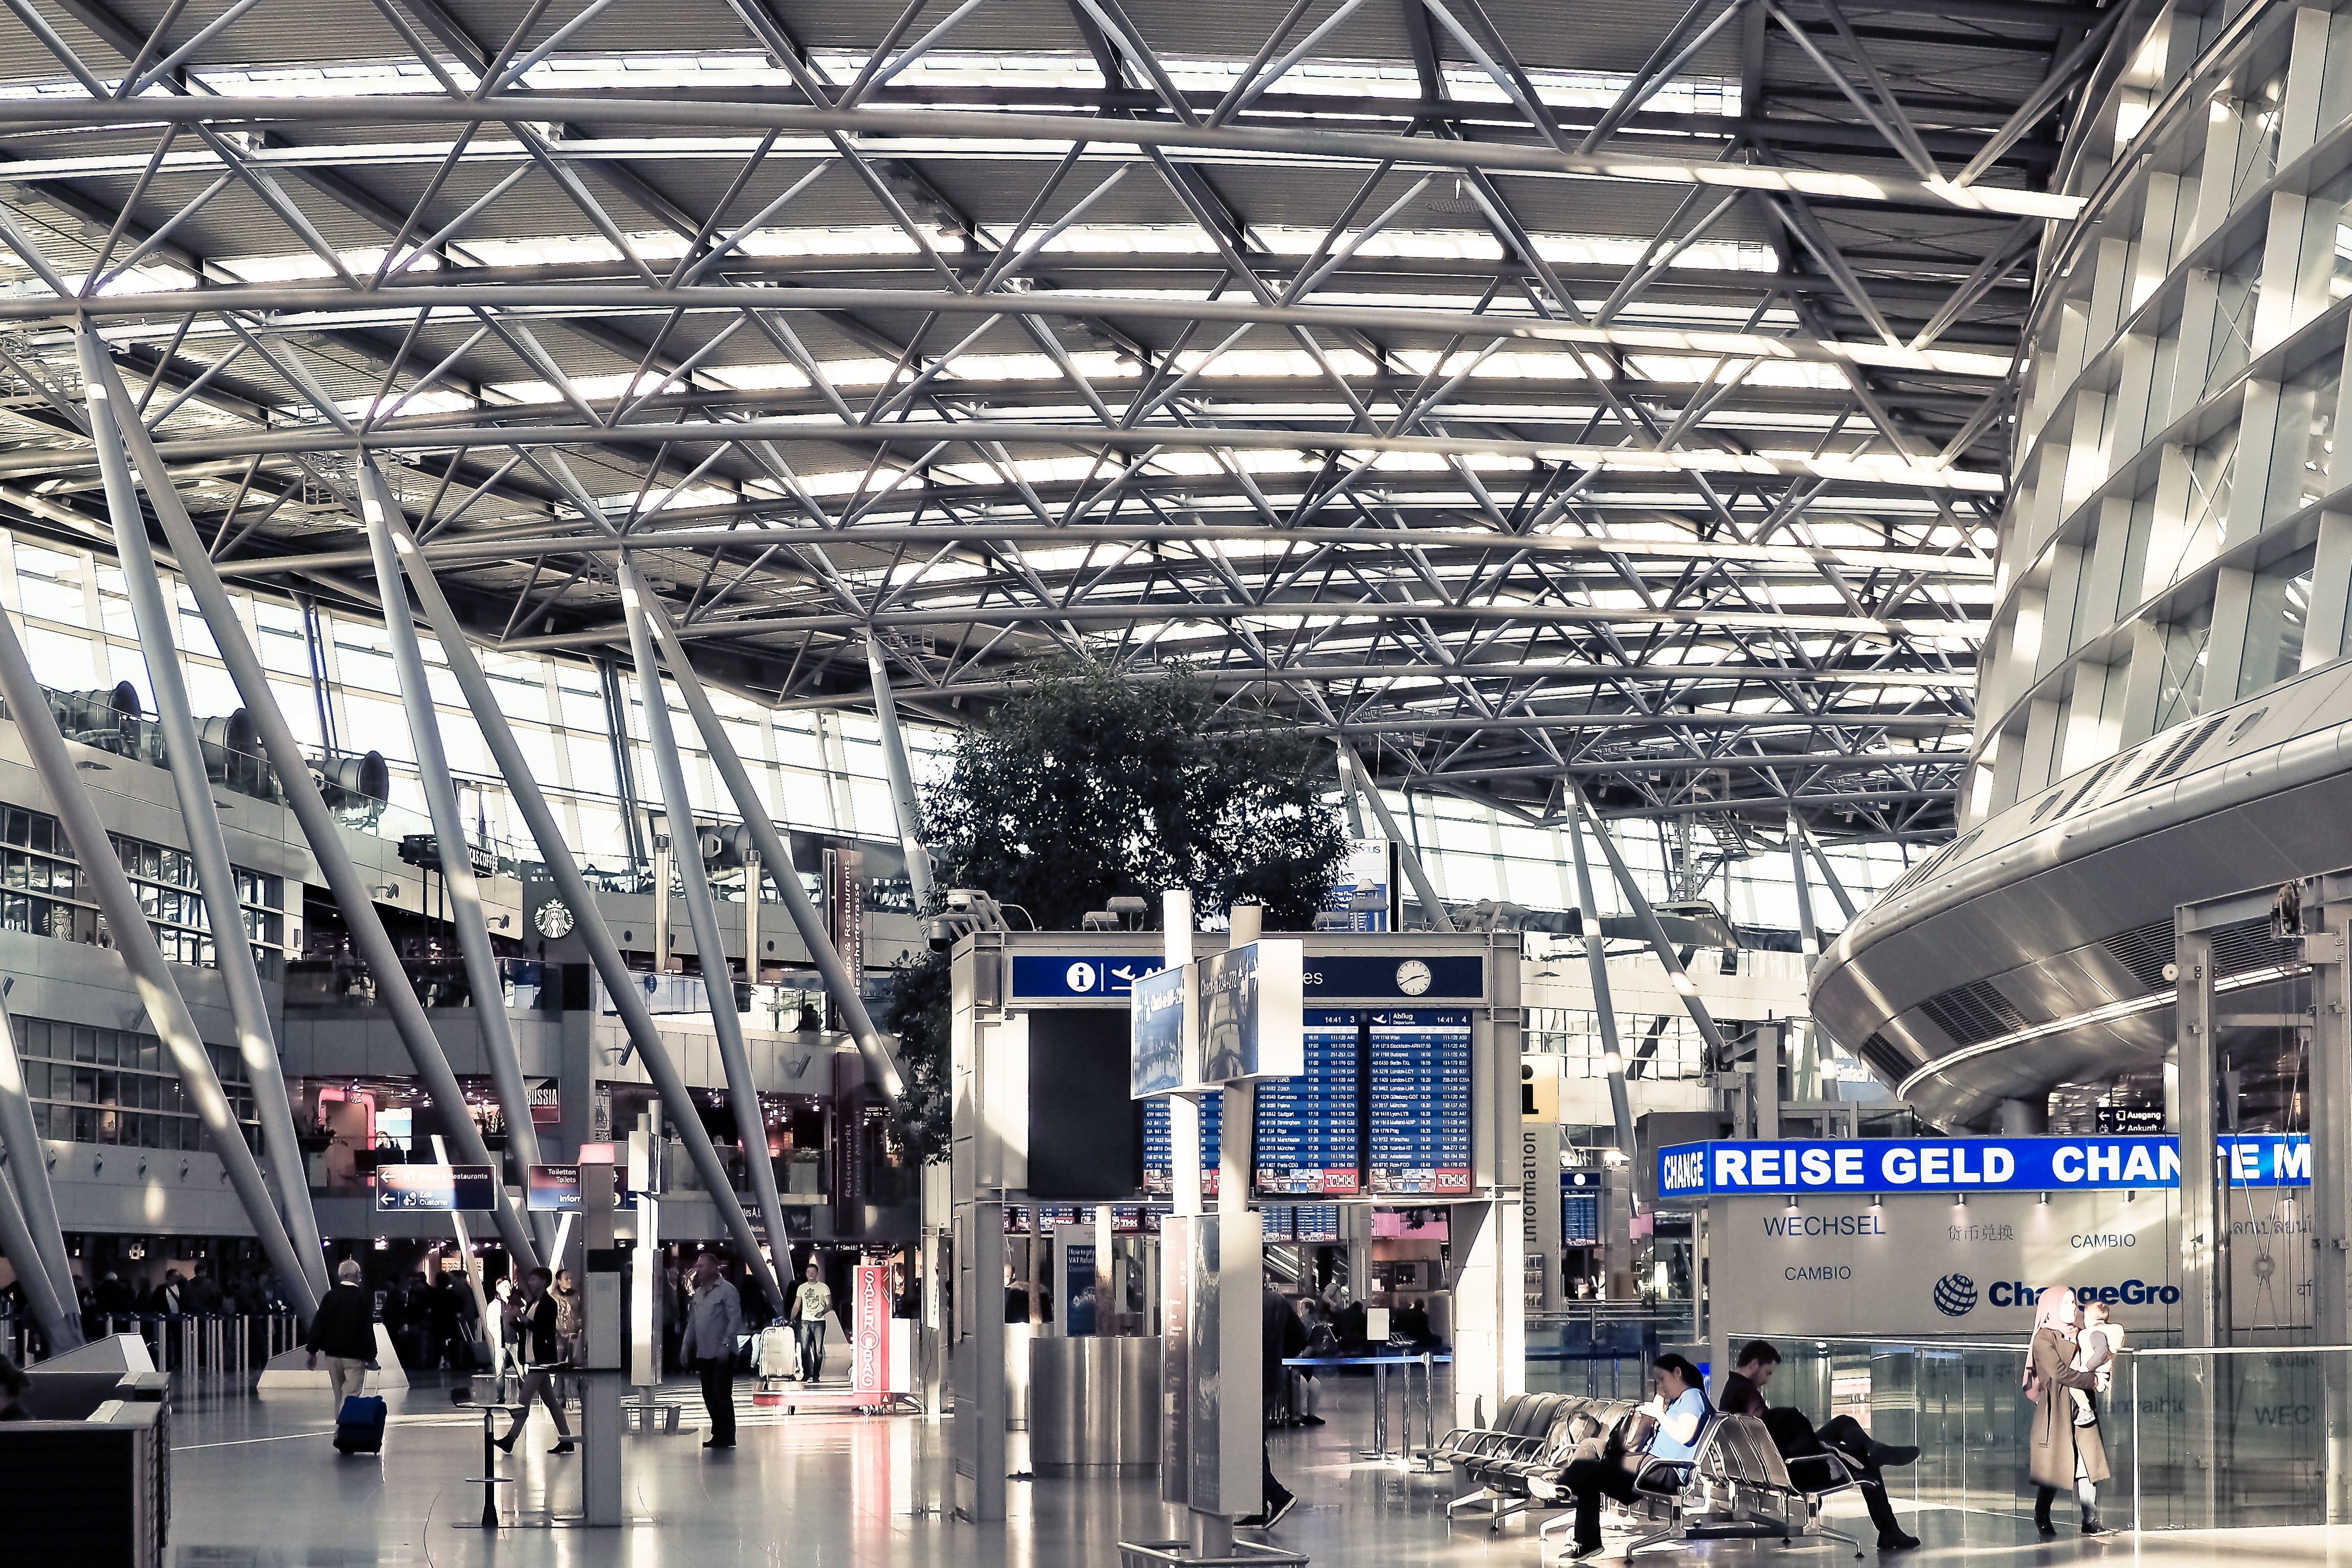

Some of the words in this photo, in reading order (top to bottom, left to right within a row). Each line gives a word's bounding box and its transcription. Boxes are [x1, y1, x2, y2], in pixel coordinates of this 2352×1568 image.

[480, 851, 498, 871] COFFEE
[526, 1089, 557, 1105] RUSSIA
[2127, 1111, 2161, 1120] Ausgang
[1663, 1151, 1704, 1190] CHANGE
[1715, 1148, 1864, 1186] REISE
[1881, 1147, 2015, 1185] GELD
[1522, 1132, 1537, 1242] Information
[1763, 1215, 1886, 1237] WECHSEL
[1948, 1225, 2014, 1241] 货币兑换
[2070, 1233, 2136, 1248] CAMBIO
[1784, 1266, 1852, 1281] CAMBIO
[1989, 1279, 2180, 1312] ChgeGro
